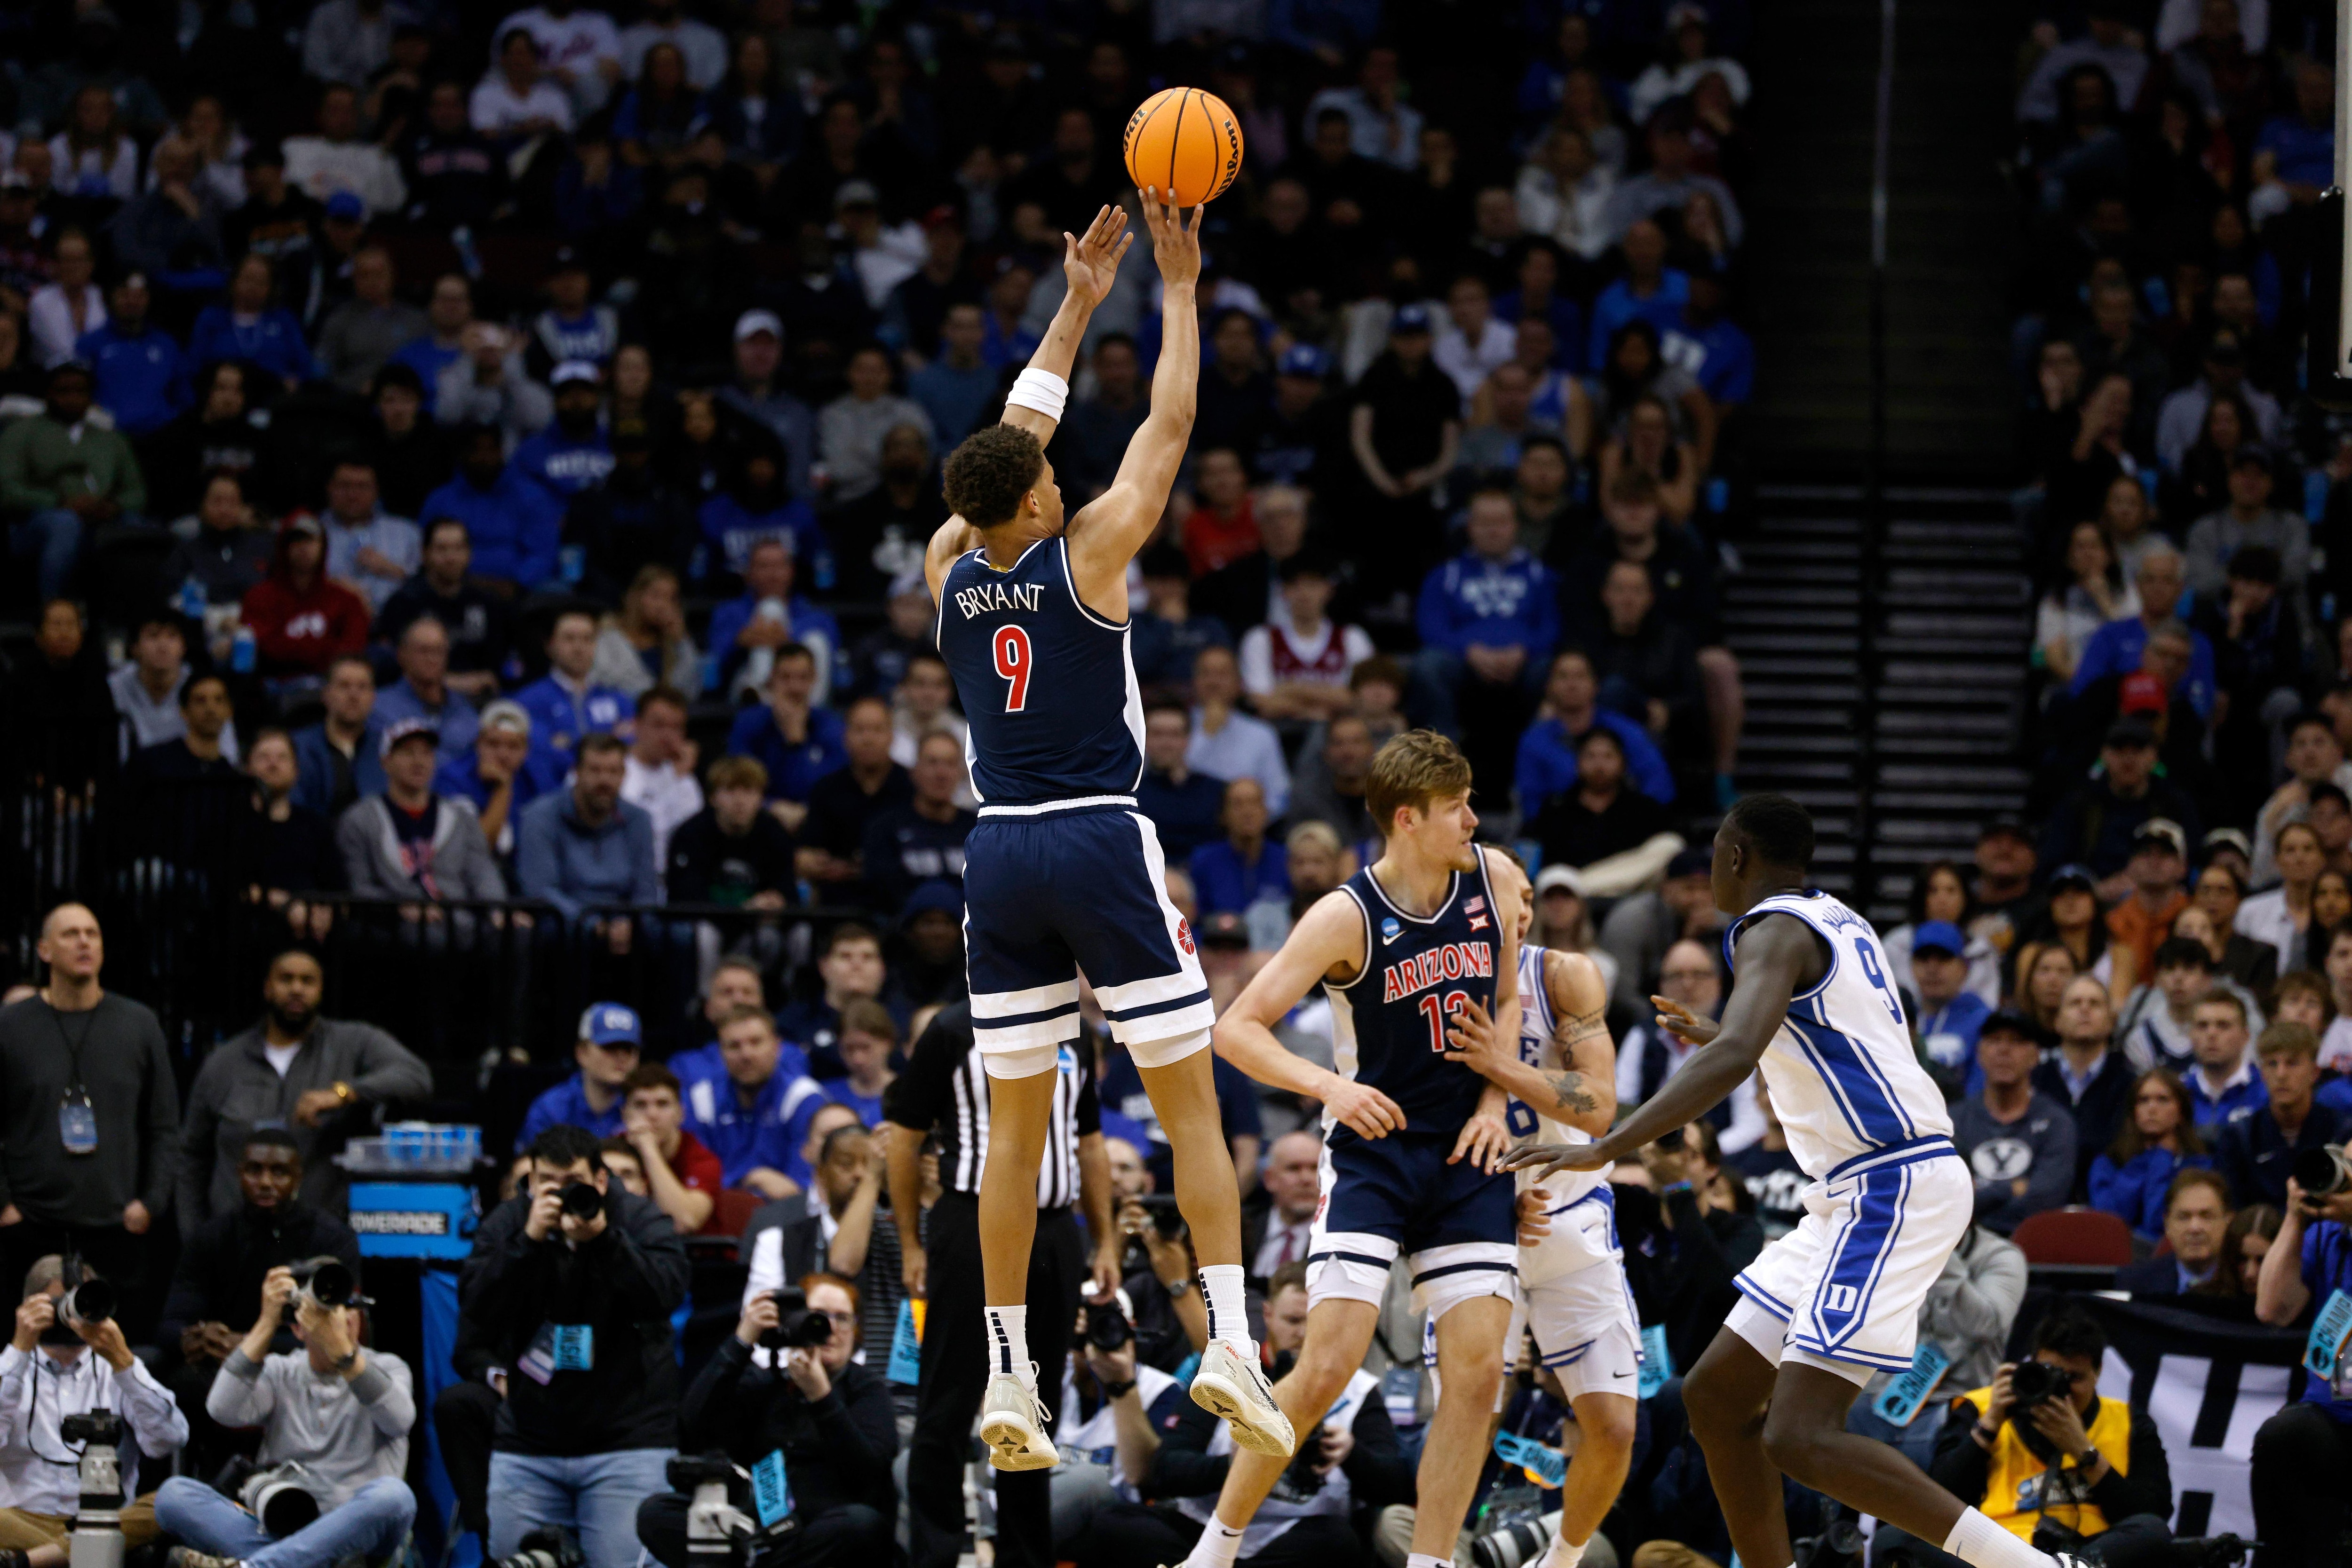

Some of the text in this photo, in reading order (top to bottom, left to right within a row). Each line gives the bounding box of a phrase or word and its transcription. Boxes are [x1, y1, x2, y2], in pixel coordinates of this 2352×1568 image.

[1212, 118, 1239, 198] Wilson
[954, 583, 1045, 620] BRYANT
[992, 624, 1032, 713] 9
[1383, 941, 1493, 1004] ARIZONA
[1854, 937, 1902, 1024] 9
[1418, 990, 1472, 1053] 13
[349, 1211, 447, 1235] OWERADE
[1823, 1283, 1858, 1313] D
